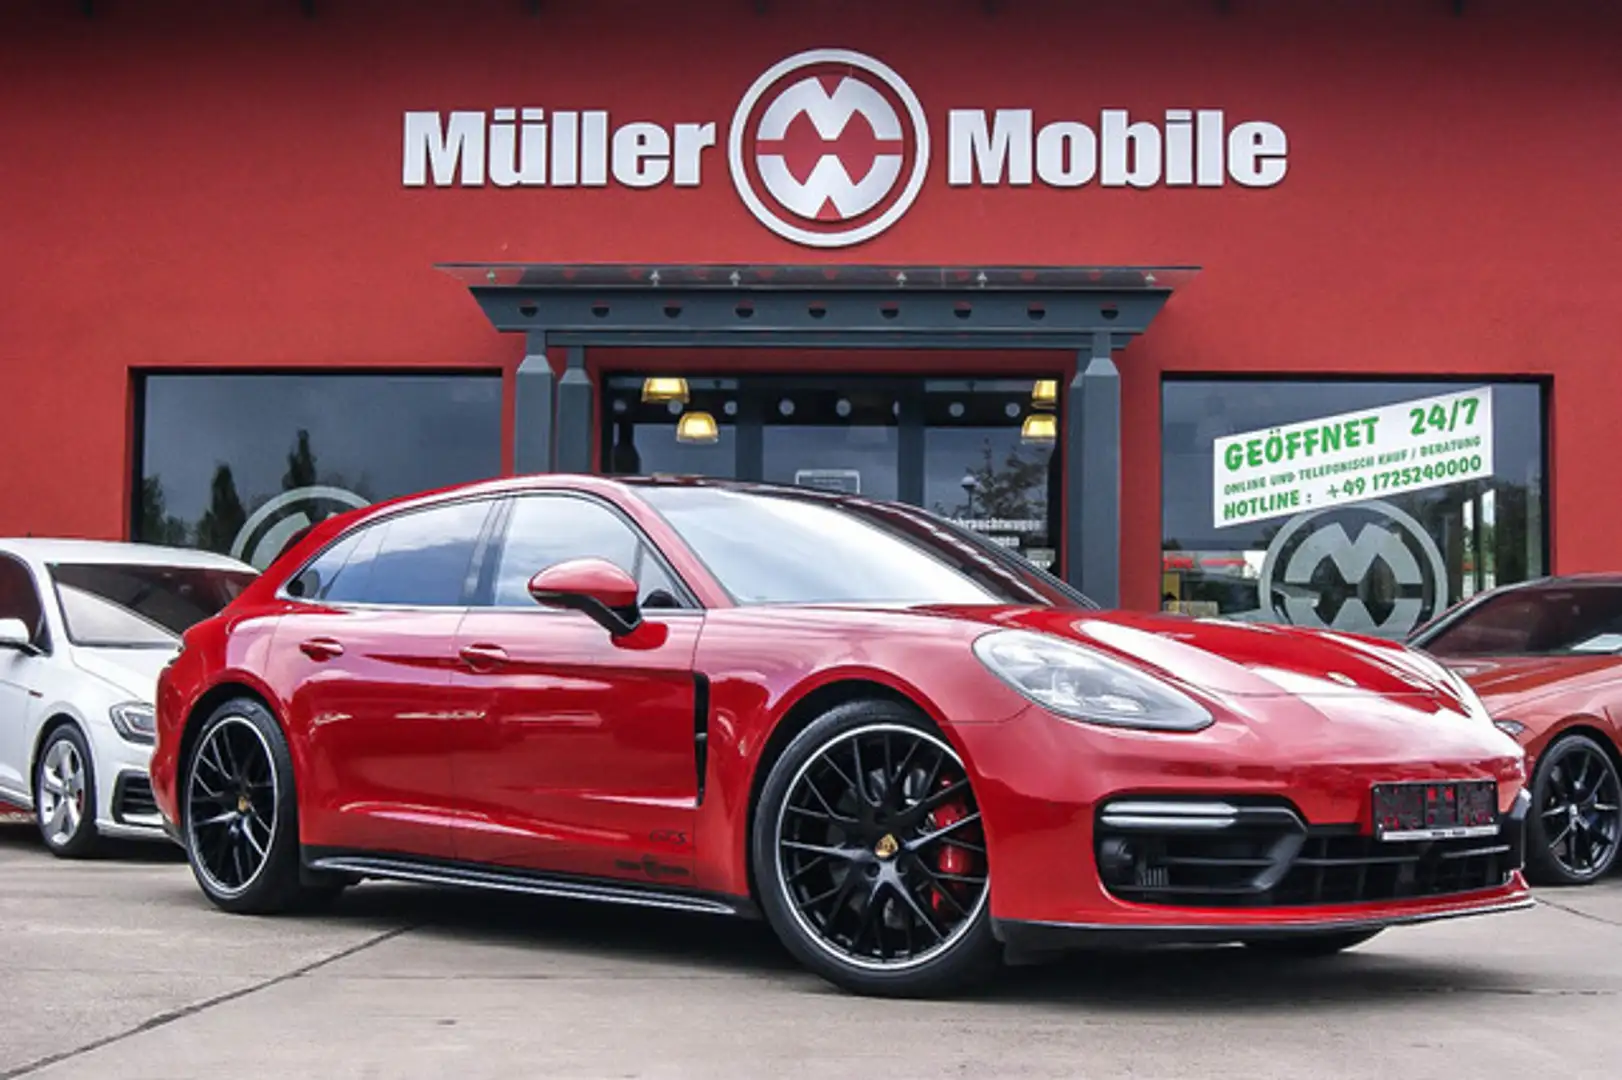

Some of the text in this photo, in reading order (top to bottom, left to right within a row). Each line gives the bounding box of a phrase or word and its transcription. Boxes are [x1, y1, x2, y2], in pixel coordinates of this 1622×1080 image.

[402, 107, 1288, 187] Müller Mobile
[1224, 397, 1480, 472] GEÖFFNET 24/7
[1224, 476, 1267, 496] ONLINE
[1269, 471, 1296, 487] UND
[1378, 448, 1408, 465] KAUF
[1420, 435, 1481, 458] BERATUNG
[1224, 489, 1300, 520] HOTLINE
[1372, 454, 1482, 491] 1725240000
